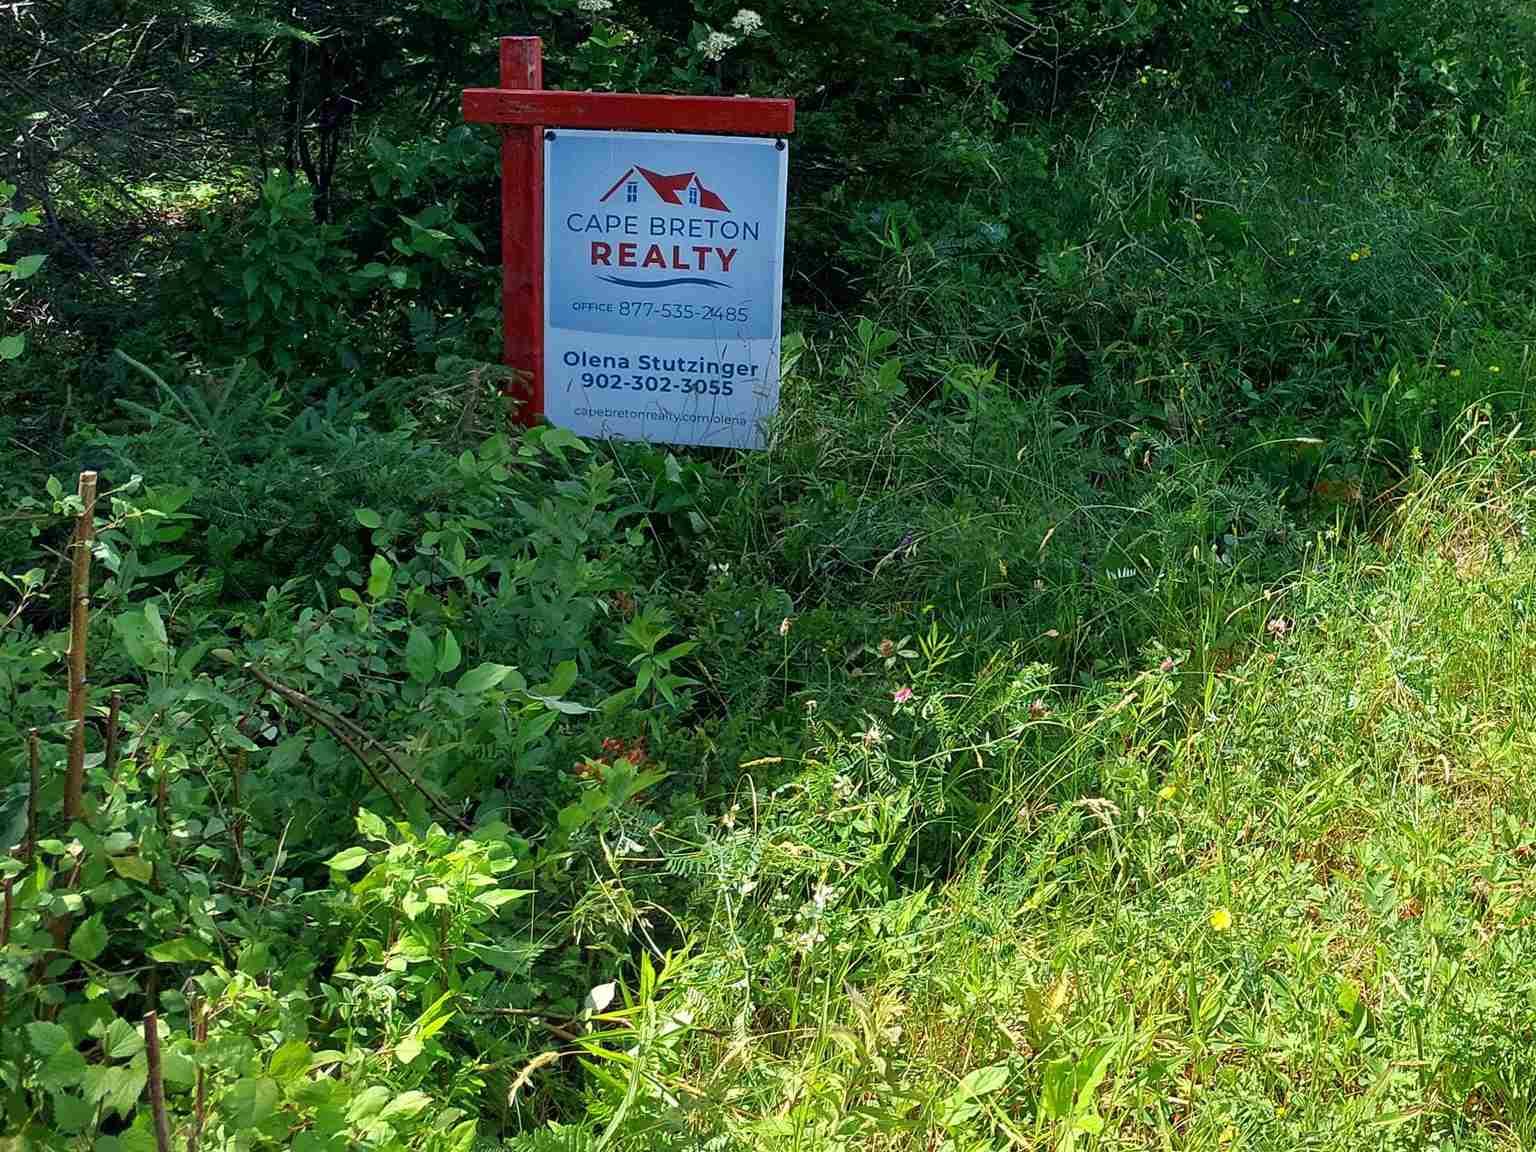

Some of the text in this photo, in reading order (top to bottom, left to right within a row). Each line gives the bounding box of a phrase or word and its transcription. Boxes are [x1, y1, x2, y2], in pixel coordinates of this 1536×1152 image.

[566, 213, 761, 241] CAPE BRETON
[590, 241, 738, 273] REALTY
[618, 301, 749, 322] 877-535-2485
[563, 351, 759, 379] Olena Stutzinger
[581, 373, 734, 396] 902-302-3055
